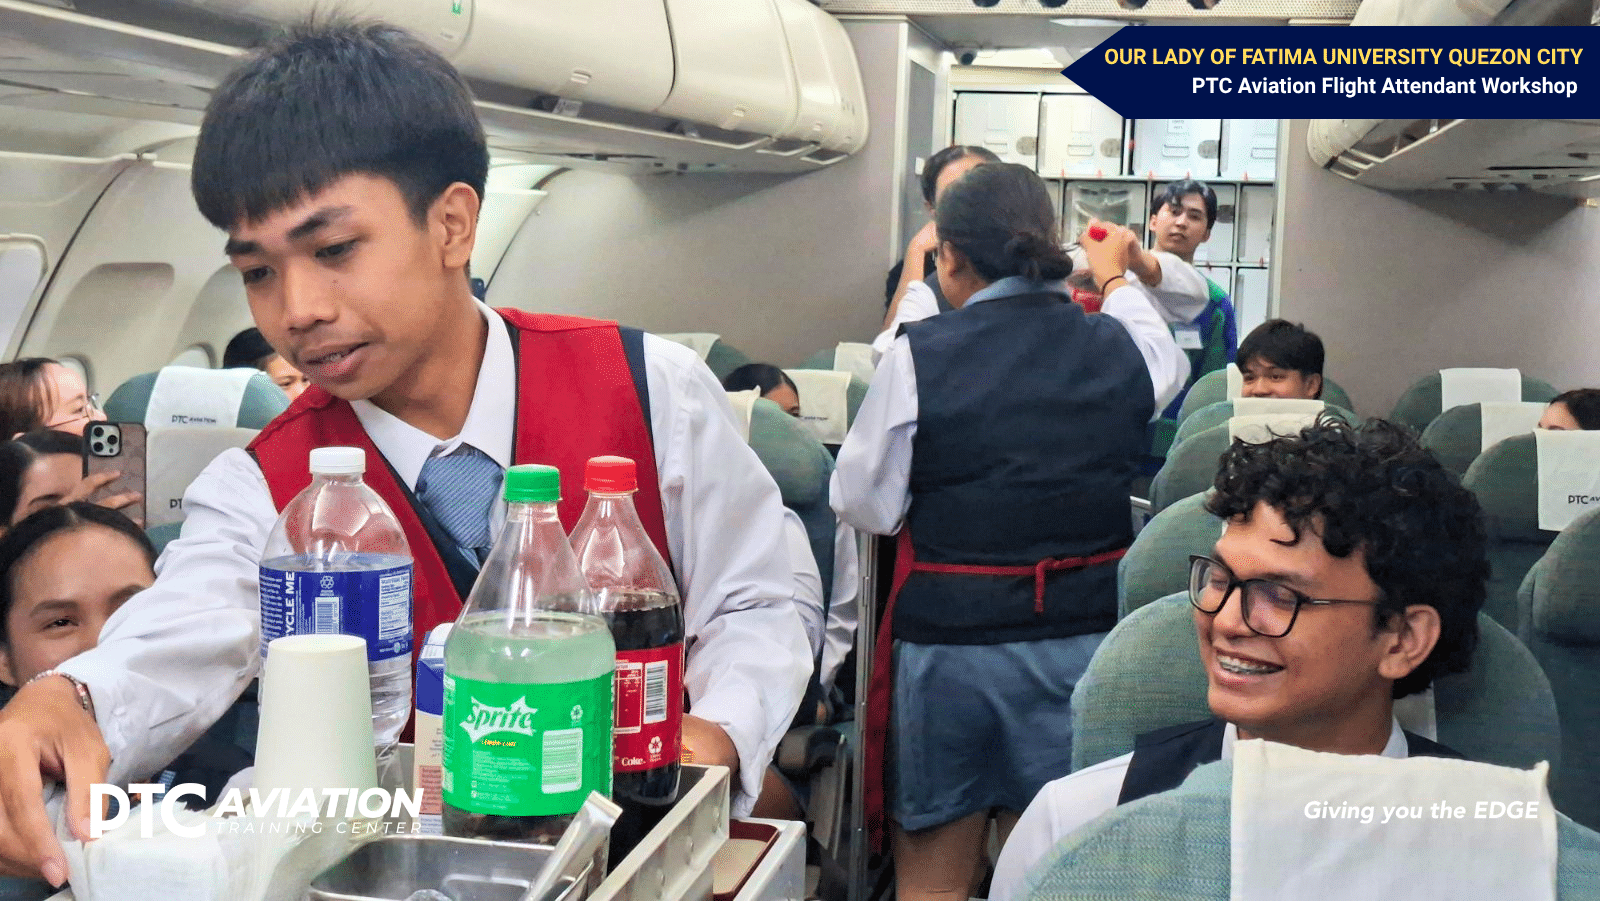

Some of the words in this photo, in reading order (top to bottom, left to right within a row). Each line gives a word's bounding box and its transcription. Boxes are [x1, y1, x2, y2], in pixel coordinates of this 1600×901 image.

[170, 498, 182, 509] PT
[1568, 494, 1589, 505] PTC
[285, 571, 295, 595] ME
[285, 597, 295, 635] YCLE
[464, 701, 533, 732] Sprite
